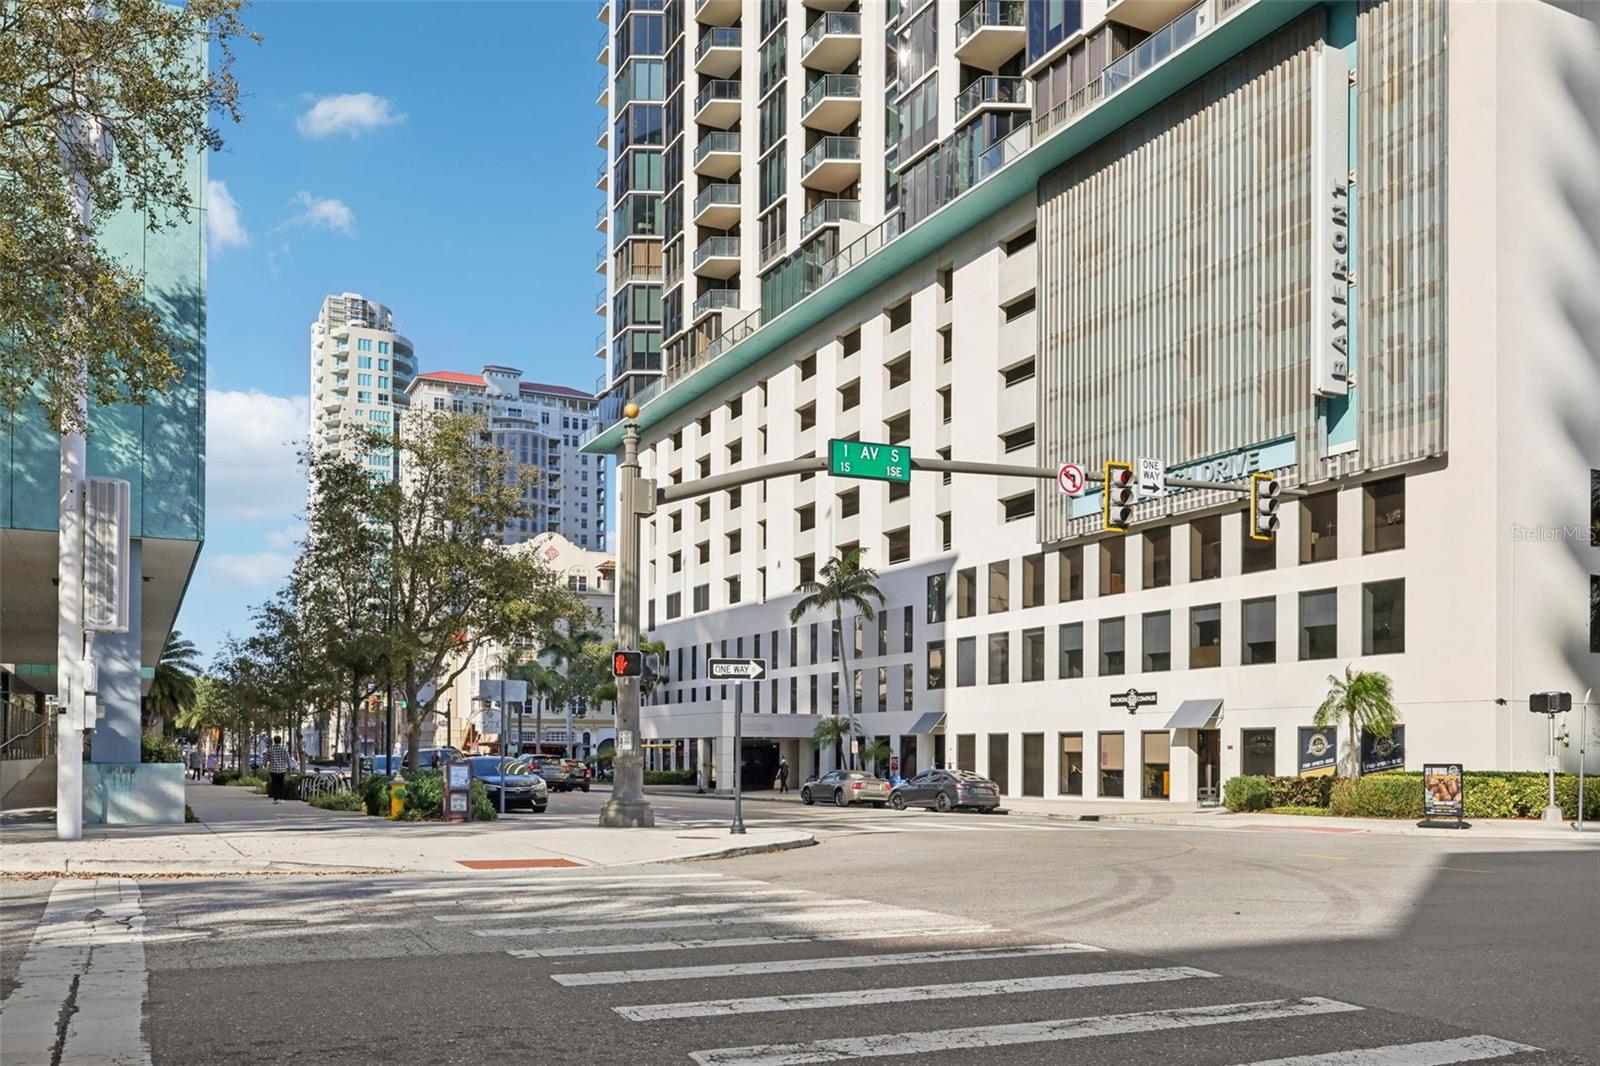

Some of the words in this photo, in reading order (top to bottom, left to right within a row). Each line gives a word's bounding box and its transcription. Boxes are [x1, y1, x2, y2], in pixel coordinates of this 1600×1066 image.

[1331, 178, 1347, 382] BAYFRONT
[843, 444, 848, 457] 1
[860, 446, 879, 460] AV
[891, 449, 899, 462] S
[840, 461, 851, 472] 1S
[1143, 460, 1159, 470] ONE
[1201, 451, 1260, 483] DRIVE
[886, 466, 902, 477] 1SE
[1143, 471, 1160, 480] WAY
[714, 665, 731, 673] ONE
[733, 665, 750, 673] WAY
